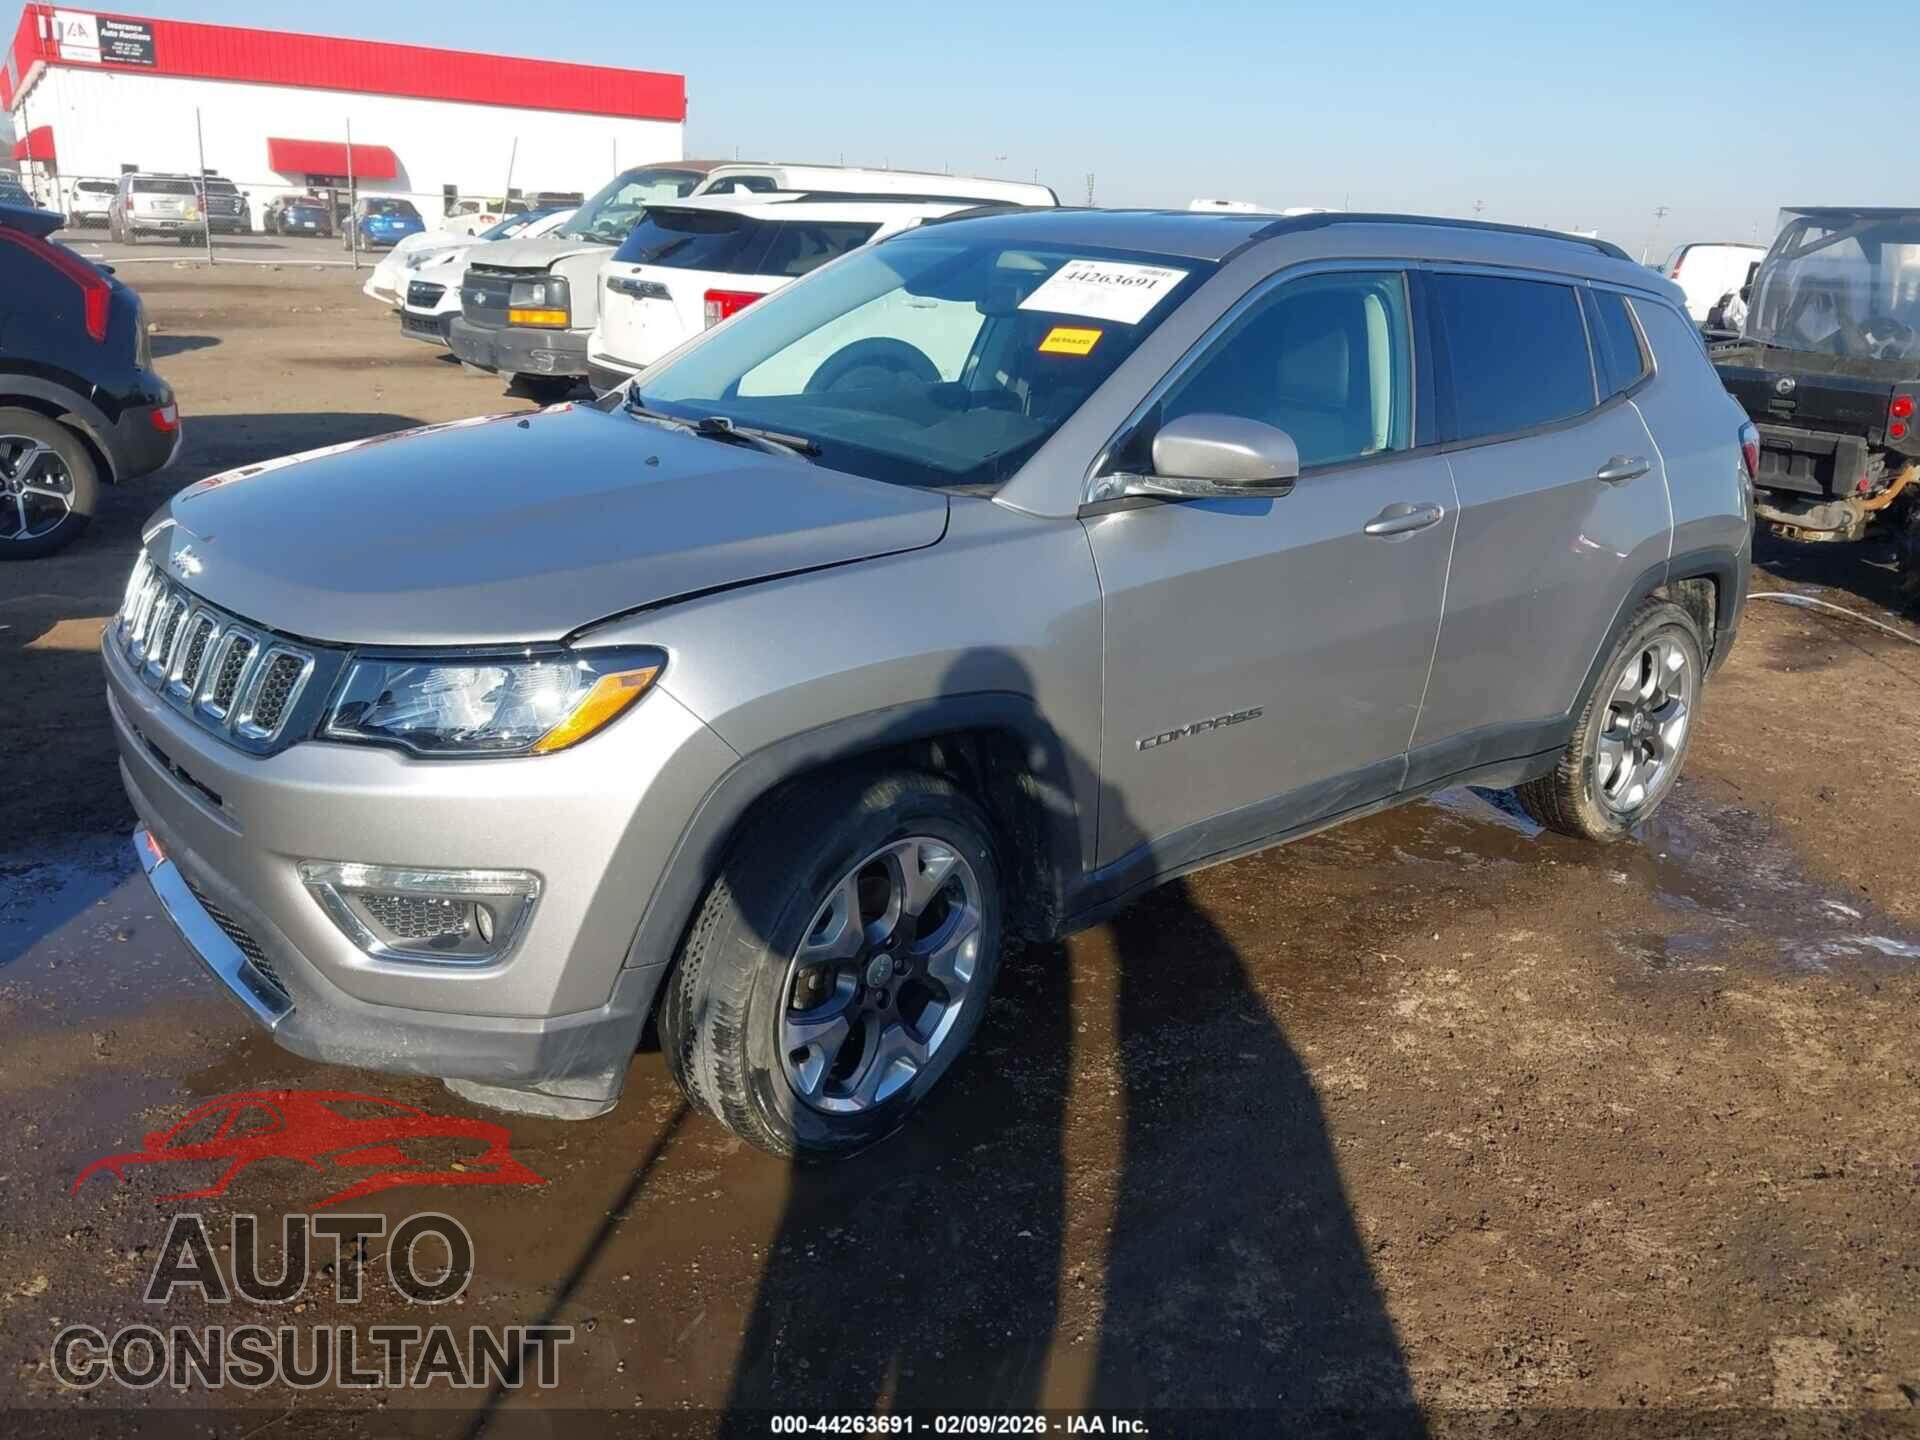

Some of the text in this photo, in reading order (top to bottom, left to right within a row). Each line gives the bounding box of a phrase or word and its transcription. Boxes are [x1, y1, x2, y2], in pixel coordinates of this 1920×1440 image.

[101, 28, 151, 41] Auto Auctions
[1064, 271, 1160, 289] 44263691
[1136, 704, 1264, 751] COMPASS
